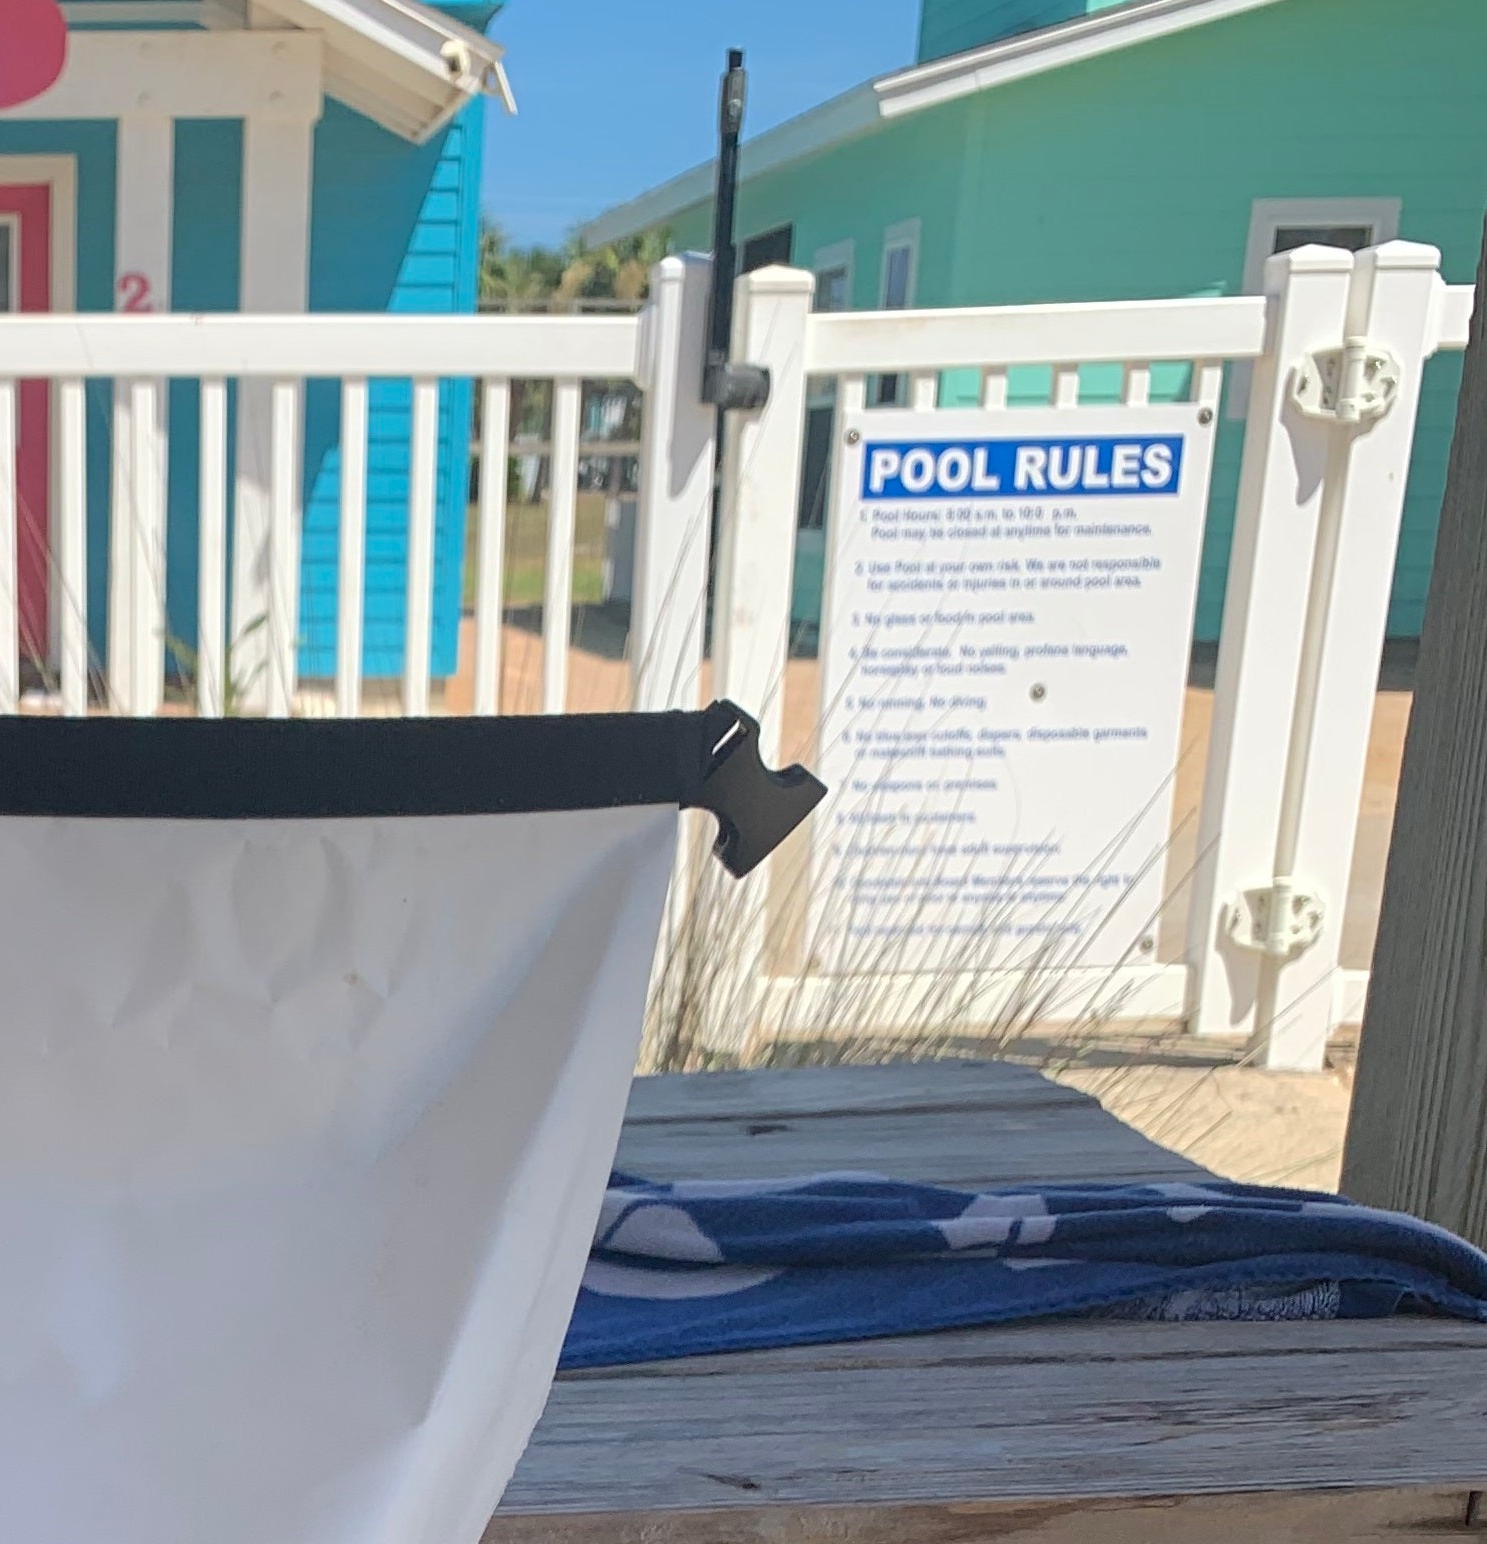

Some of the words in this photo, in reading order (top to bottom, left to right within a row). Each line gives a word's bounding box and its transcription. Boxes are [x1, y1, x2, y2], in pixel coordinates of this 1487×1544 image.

[117, 272, 154, 314] 2
[869, 447, 1001, 493] POOL
[1015, 443, 1173, 489] RULES
